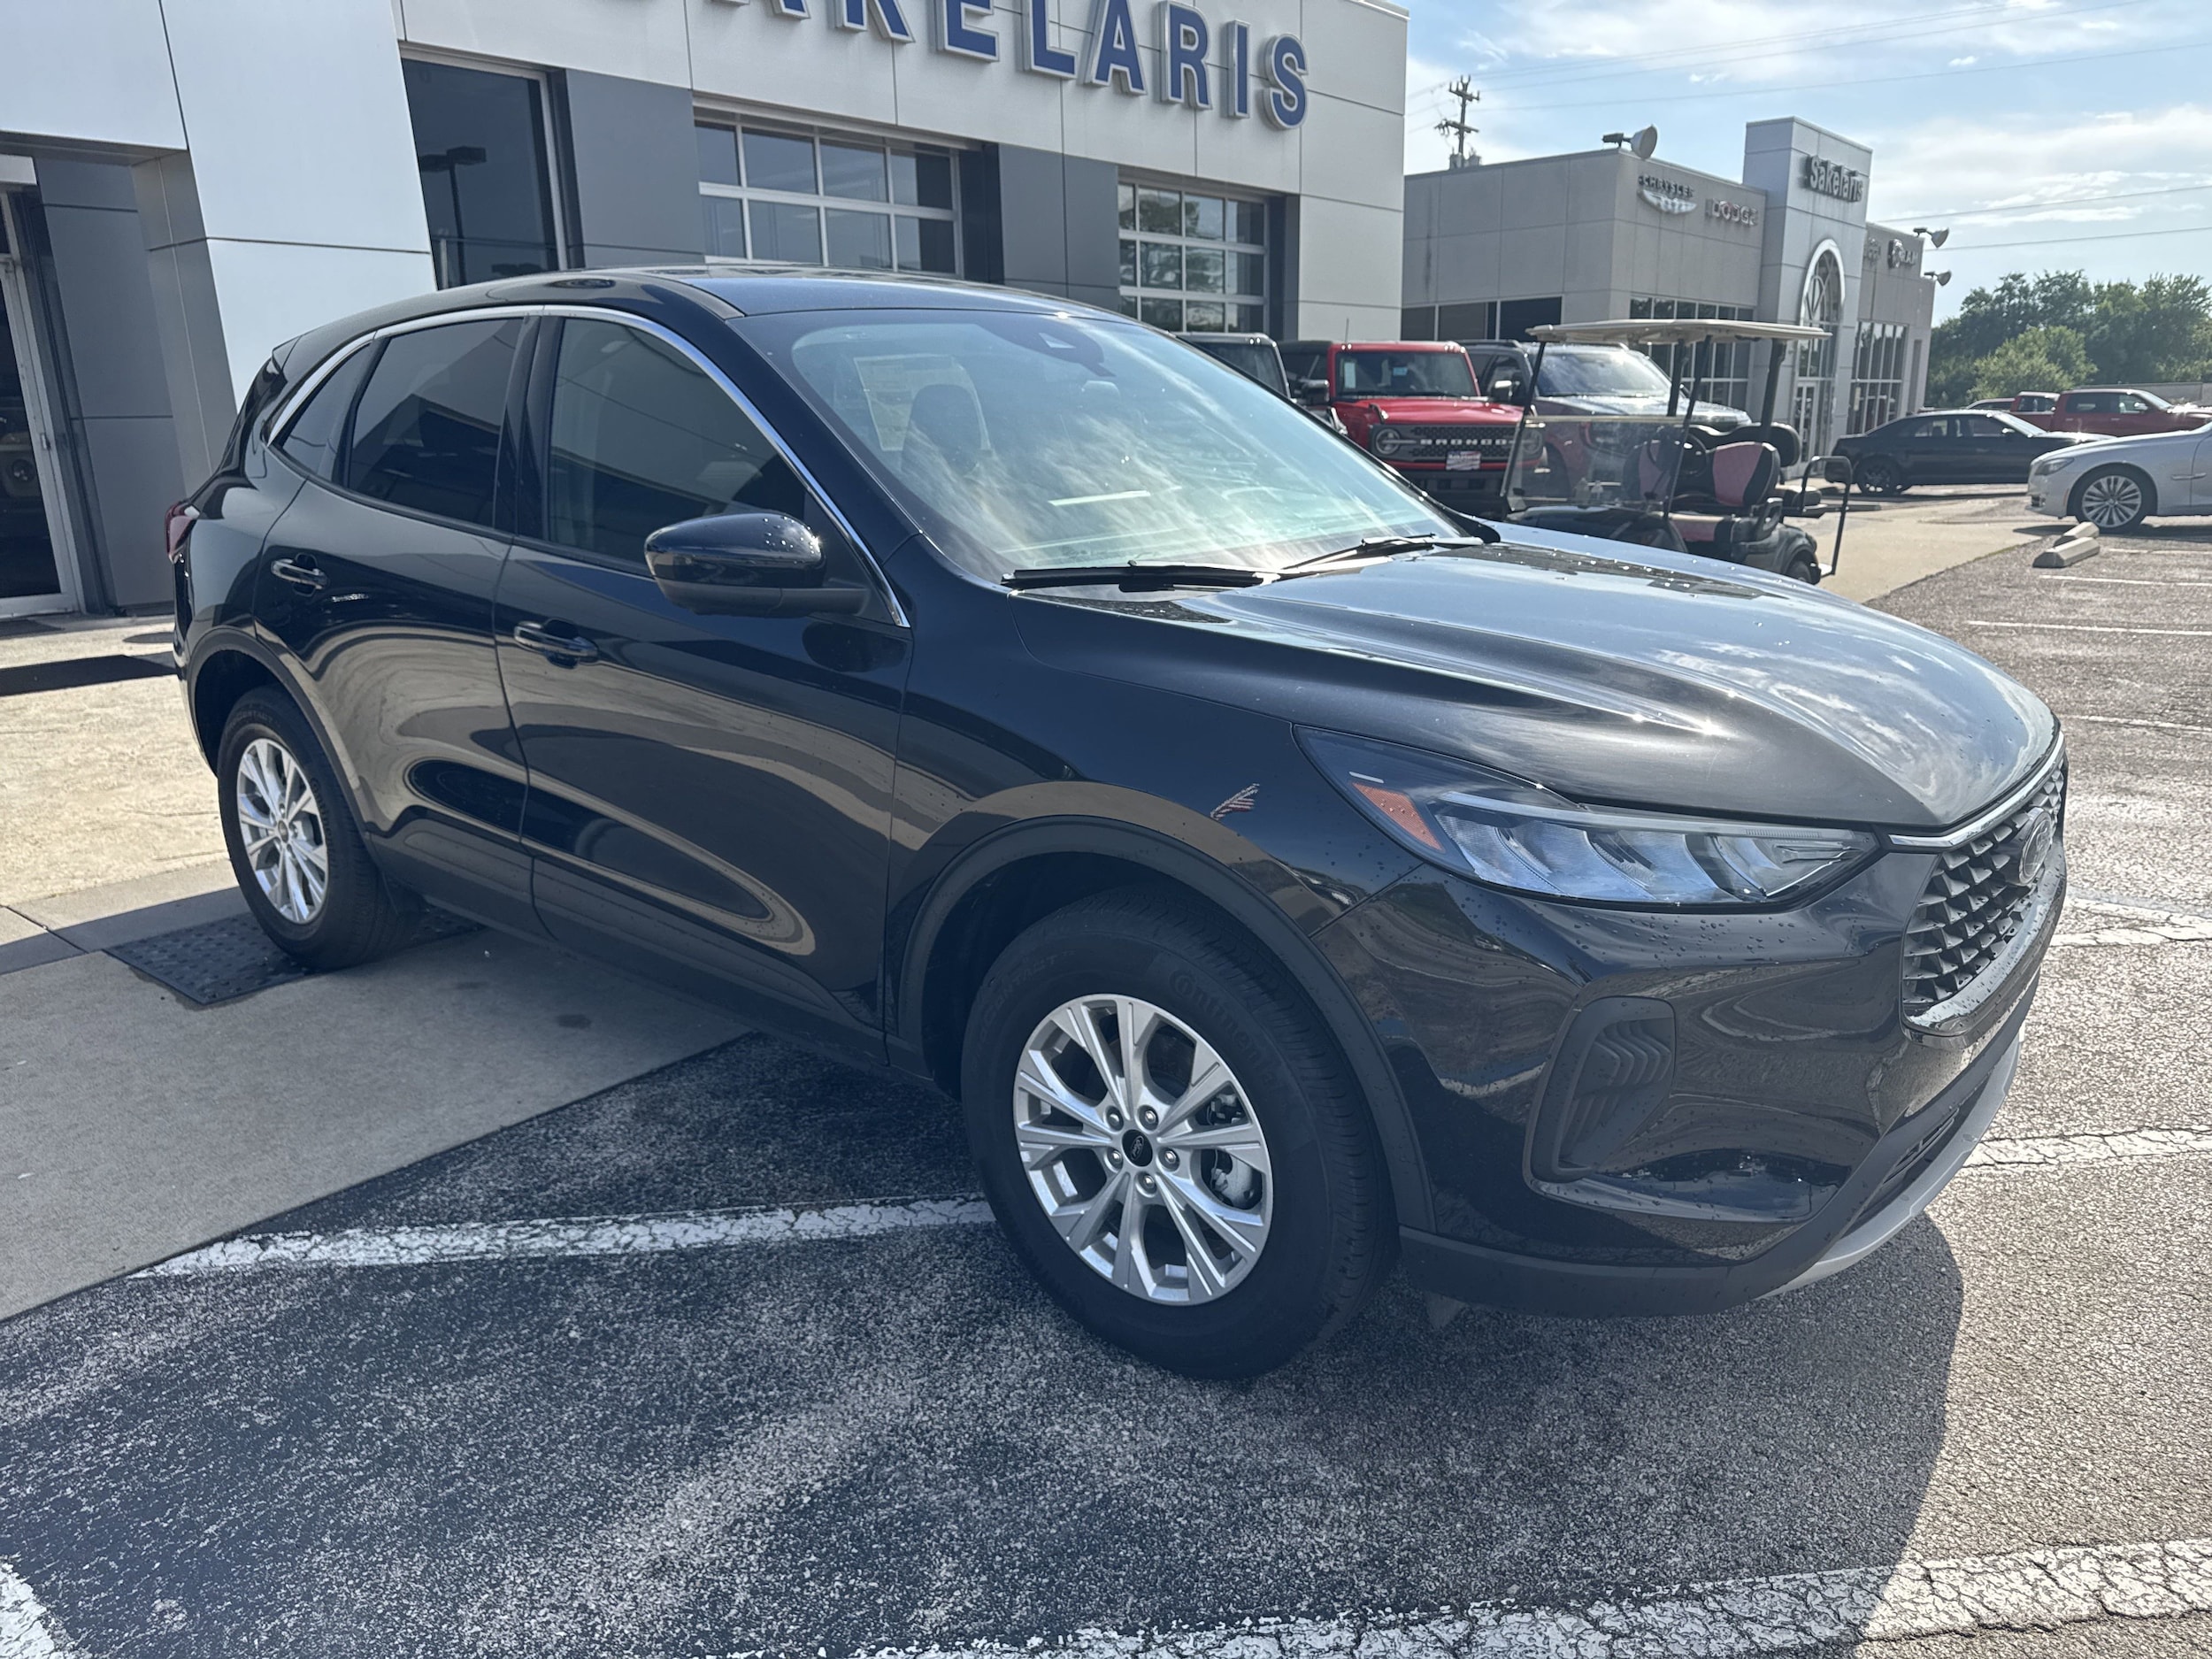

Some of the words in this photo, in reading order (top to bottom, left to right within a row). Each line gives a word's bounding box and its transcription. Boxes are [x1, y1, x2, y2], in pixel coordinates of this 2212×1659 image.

[706, 0, 1309, 129] ELARIS
[1807, 155, 1863, 203] Sakelaris
[1709, 197, 1758, 226] DODGE
